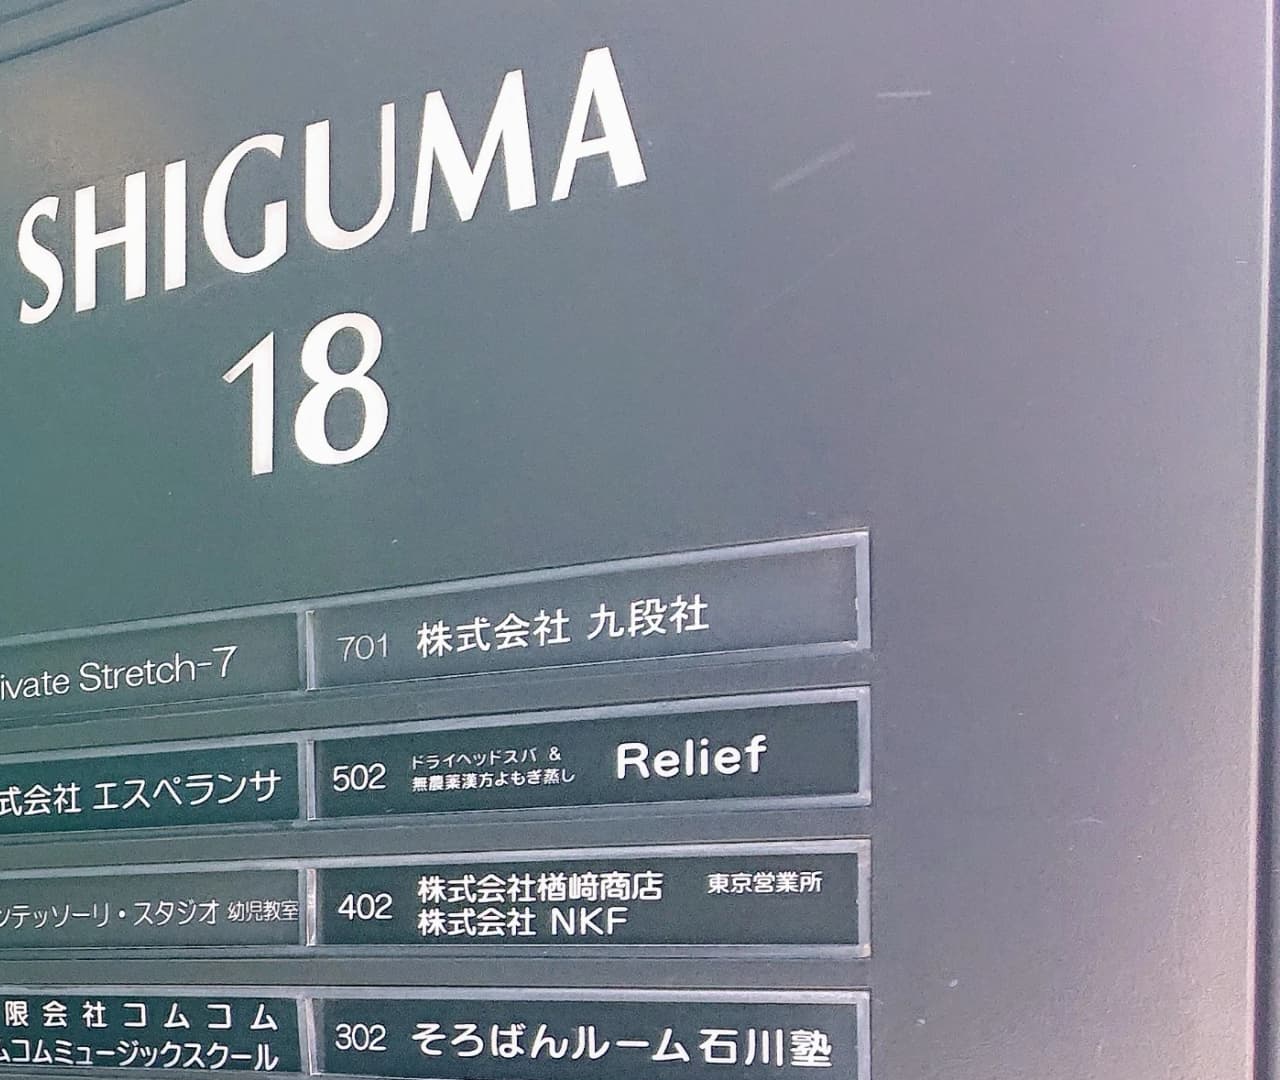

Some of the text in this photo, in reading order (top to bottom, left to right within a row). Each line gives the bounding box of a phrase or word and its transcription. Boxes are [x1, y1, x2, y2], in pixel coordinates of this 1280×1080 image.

[17, 46, 647, 325] SHIGUMA
[222, 312, 389, 476] 18
[337, 593, 710, 662] 701 株式会社 九段社
[79, 645, 238, 692] Stretch-7
[548, 746, 562, 761] &
[616, 734, 767, 779] Relief
[92, 769, 282, 810] エスペランサ
[333, 762, 386, 792] 502
[412, 768, 576, 793] 無農薬漢方よもぎ蒸し
[707, 870, 823, 894] 東京営業所
[227, 899, 299, 922] 幼児教室
[337, 893, 393, 920] 402
[417, 906, 628, 937] 株式会社 NKF
[335, 1023, 387, 1051] 302
